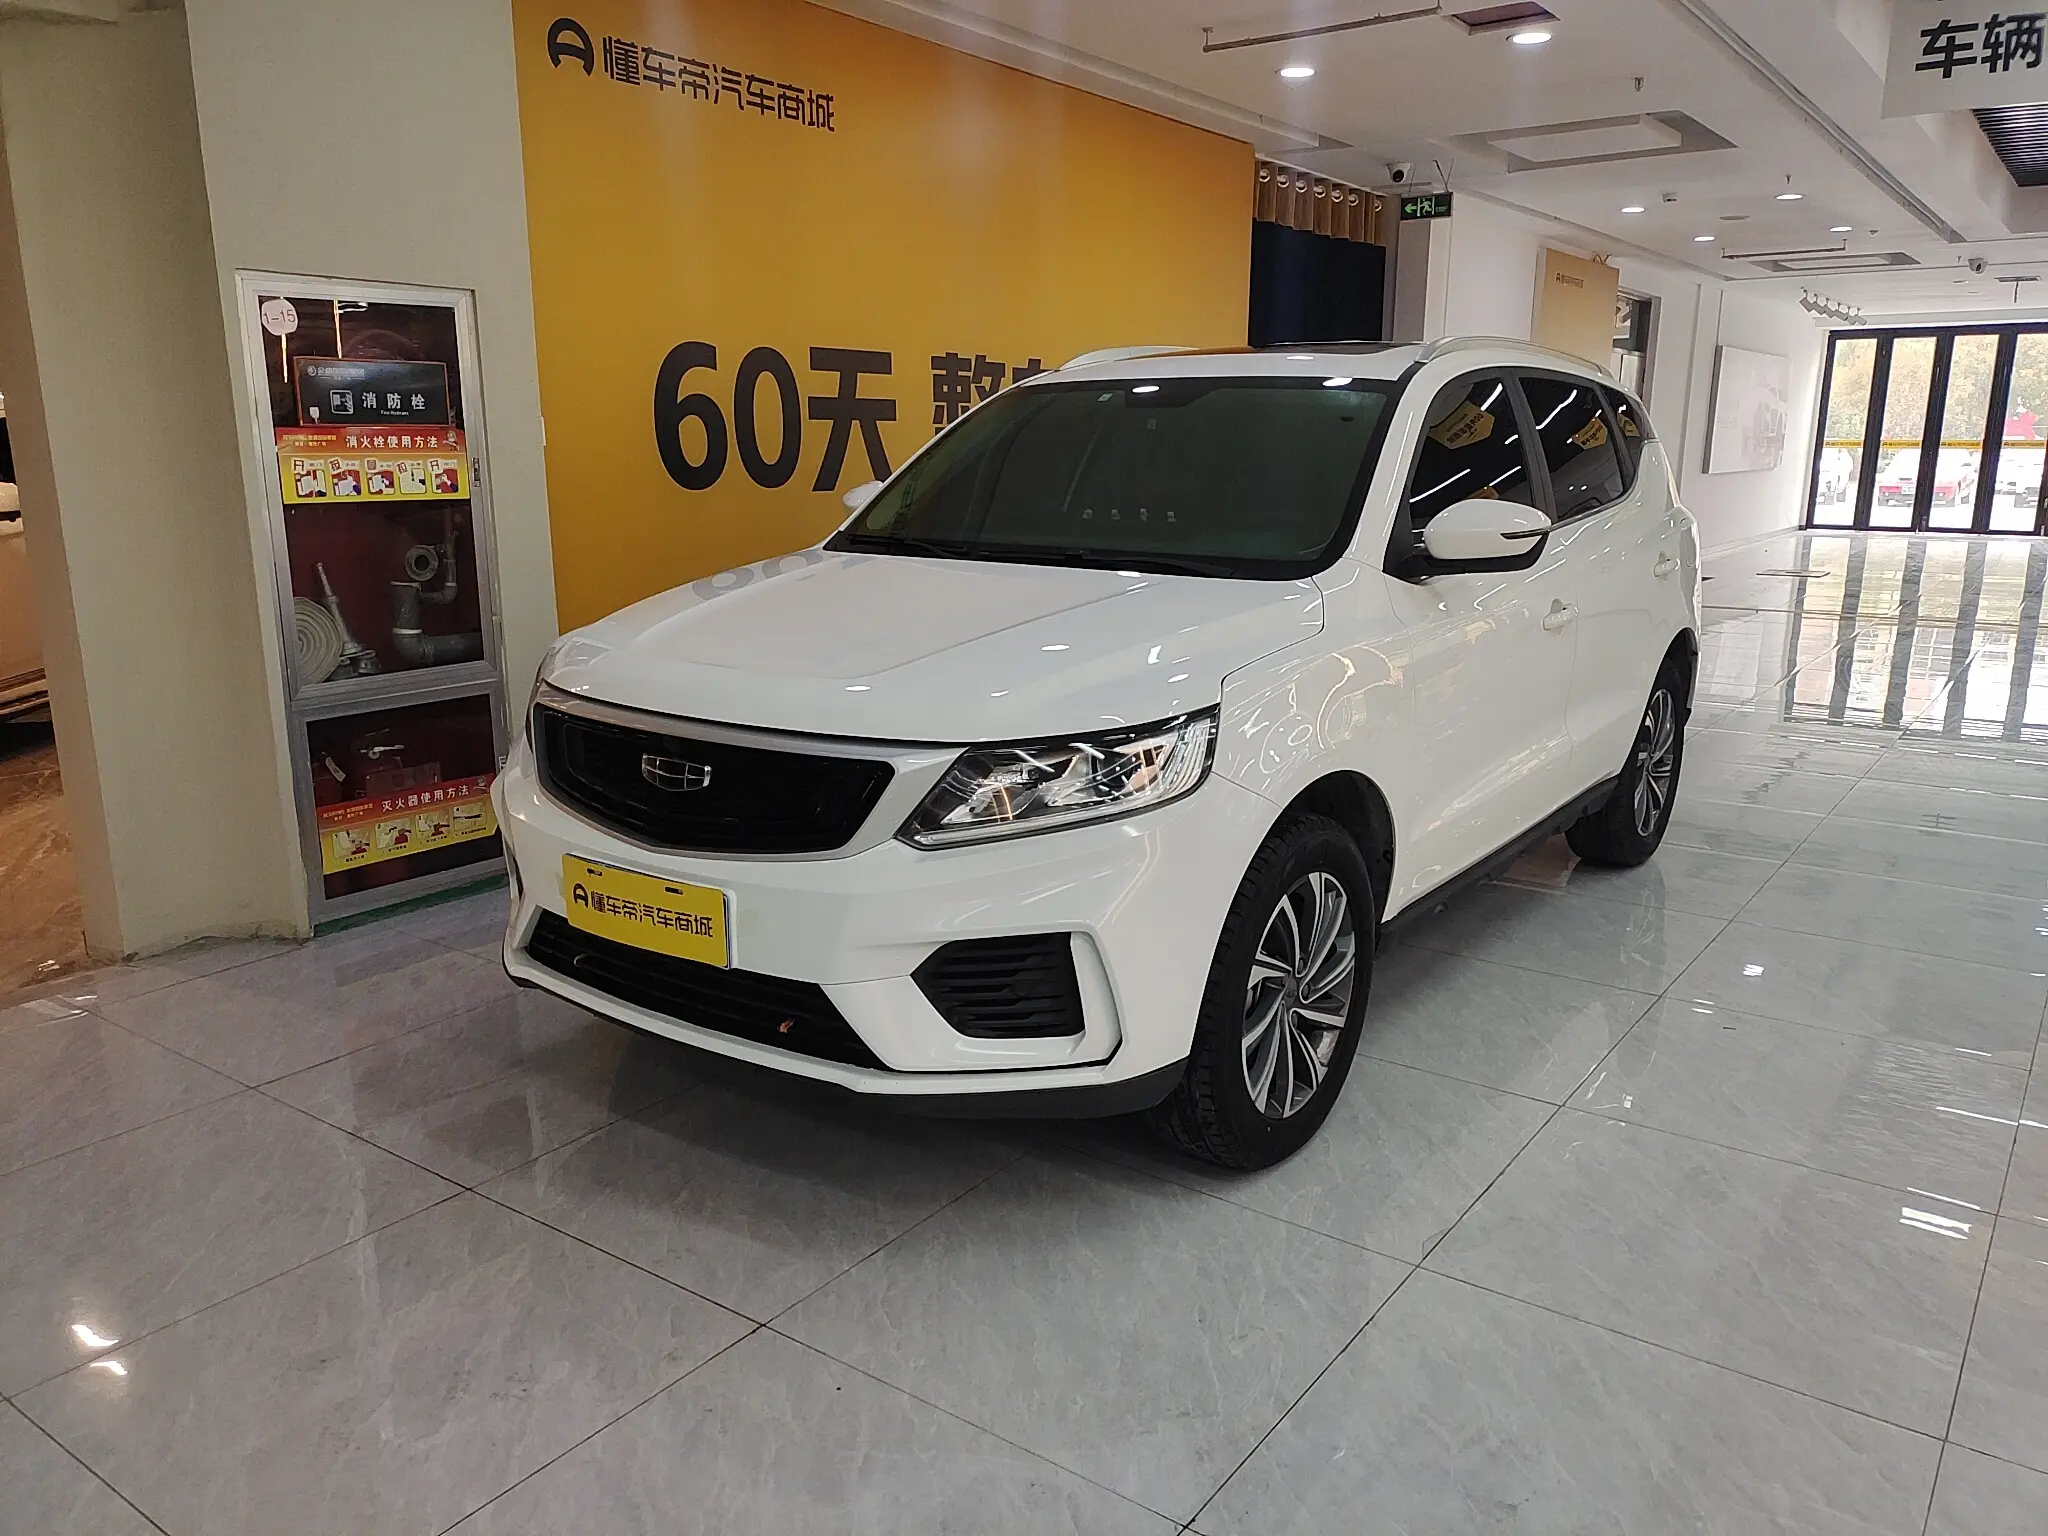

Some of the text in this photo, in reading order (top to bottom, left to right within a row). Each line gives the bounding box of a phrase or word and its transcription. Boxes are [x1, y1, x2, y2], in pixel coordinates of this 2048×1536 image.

[1915, 13, 2047, 79] 车辆
[602, 36, 835, 132] 懂车帝汽车商城
[263, 309, 296, 325] 1-15
[361, 391, 426, 410] 消防栓
[654, 341, 897, 492] 60天
[345, 435, 438, 449] 消火栓使用方法
[381, 785, 469, 812] 灭火器使用方法
[591, 891, 713, 937] 懂车帝汽车商城
